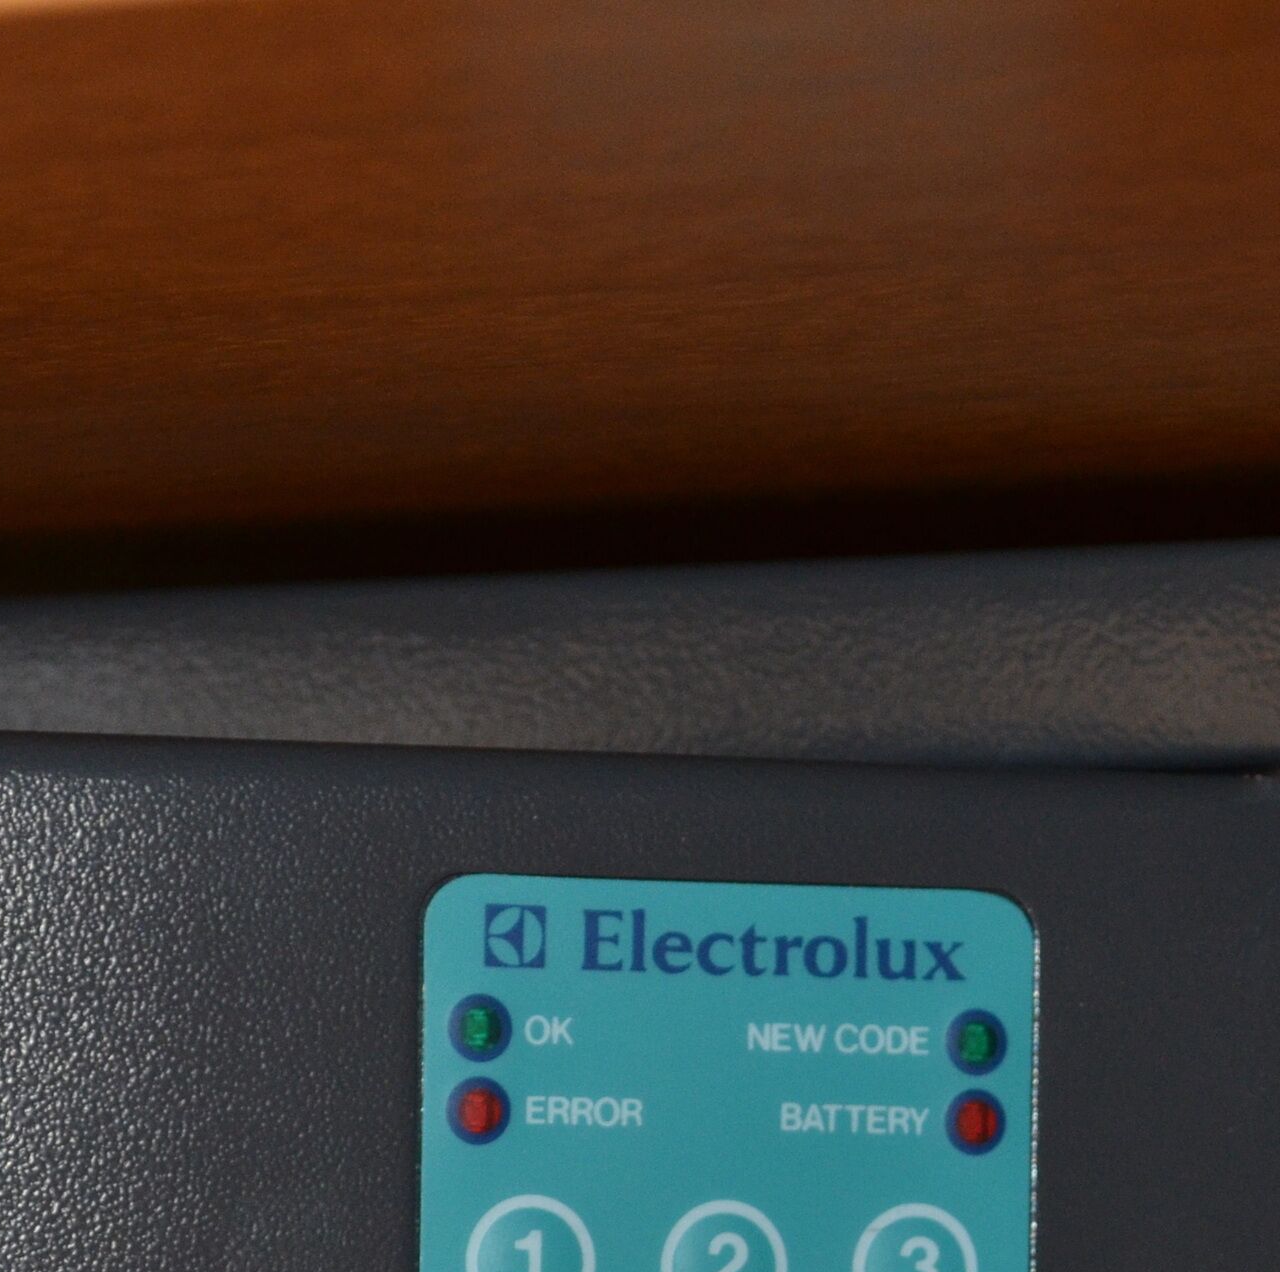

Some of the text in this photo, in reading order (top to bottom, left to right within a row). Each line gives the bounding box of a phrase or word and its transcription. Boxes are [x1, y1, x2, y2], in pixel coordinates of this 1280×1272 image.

[581, 909, 966, 982] Electrolux
[525, 1016, 573, 1046] OK
[747, 1023, 930, 1054] NEW CODE
[526, 1096, 642, 1127] ERROR
[781, 1103, 930, 1134] BATTERY
